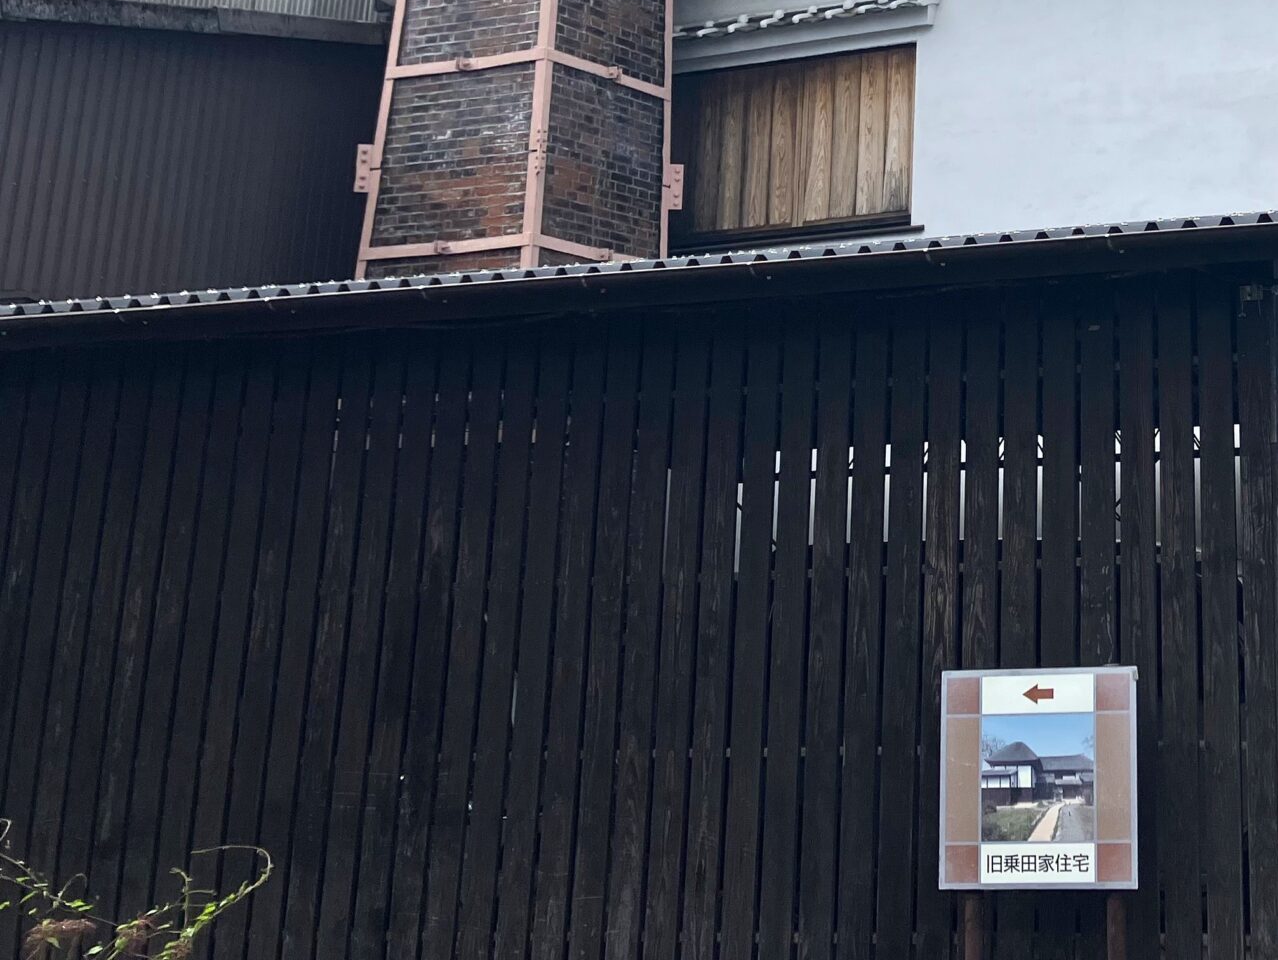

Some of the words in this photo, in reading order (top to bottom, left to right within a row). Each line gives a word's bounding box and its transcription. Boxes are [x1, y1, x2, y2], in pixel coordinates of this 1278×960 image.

[986, 853, 1089, 874] 旧乗田家住宅
